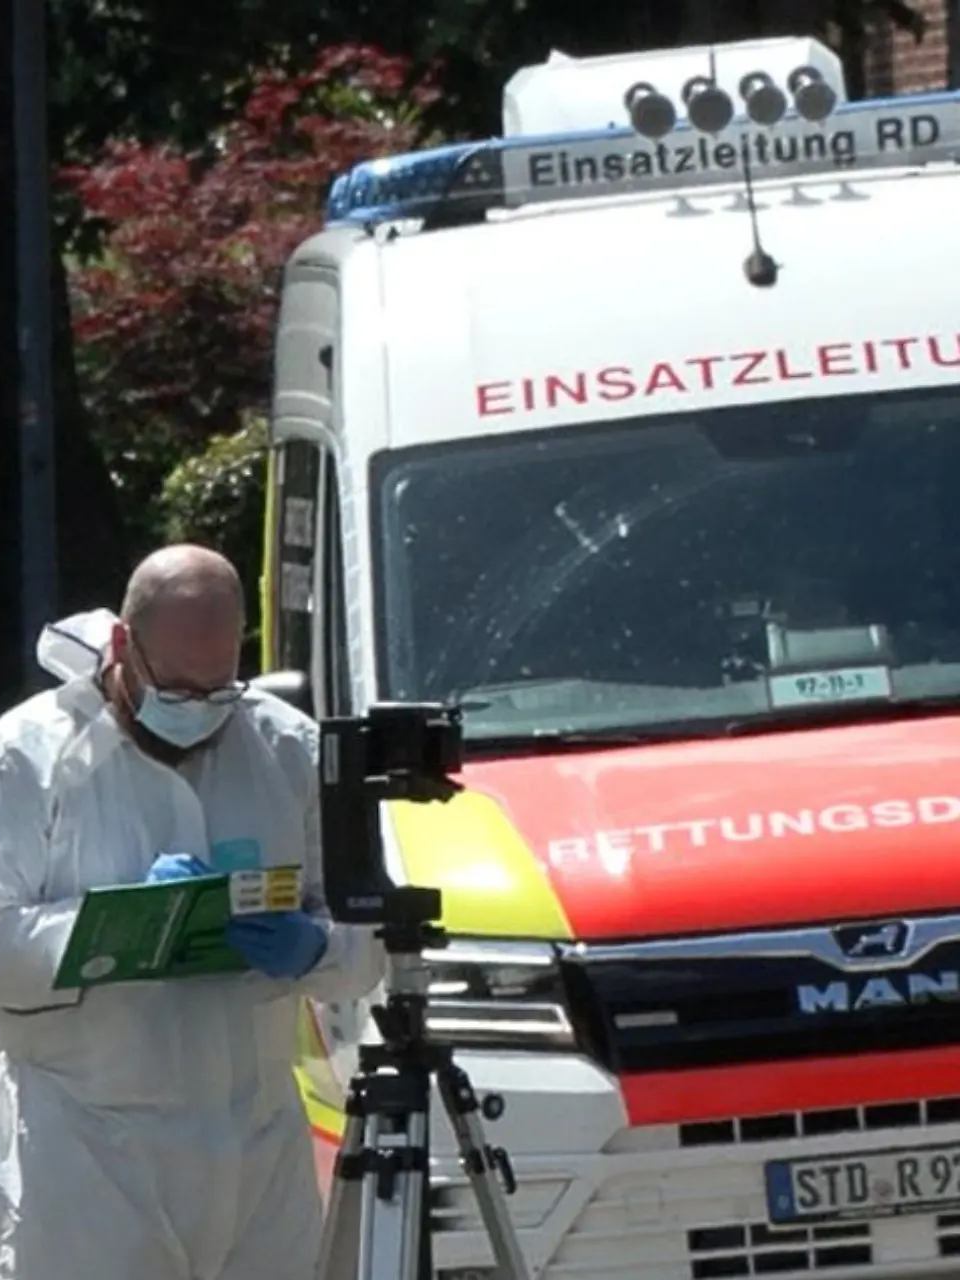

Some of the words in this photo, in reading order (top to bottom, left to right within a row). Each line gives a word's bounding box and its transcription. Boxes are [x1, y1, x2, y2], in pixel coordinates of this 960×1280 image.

[528, 129, 857, 187] Einsatzleitung
[876, 114, 940, 151] RD
[475, 332, 960, 418] EINSATZLEITU
[797, 971, 960, 1014] MAN
[796, 1161, 869, 1208] STD
[897, 1156, 923, 1198] R
